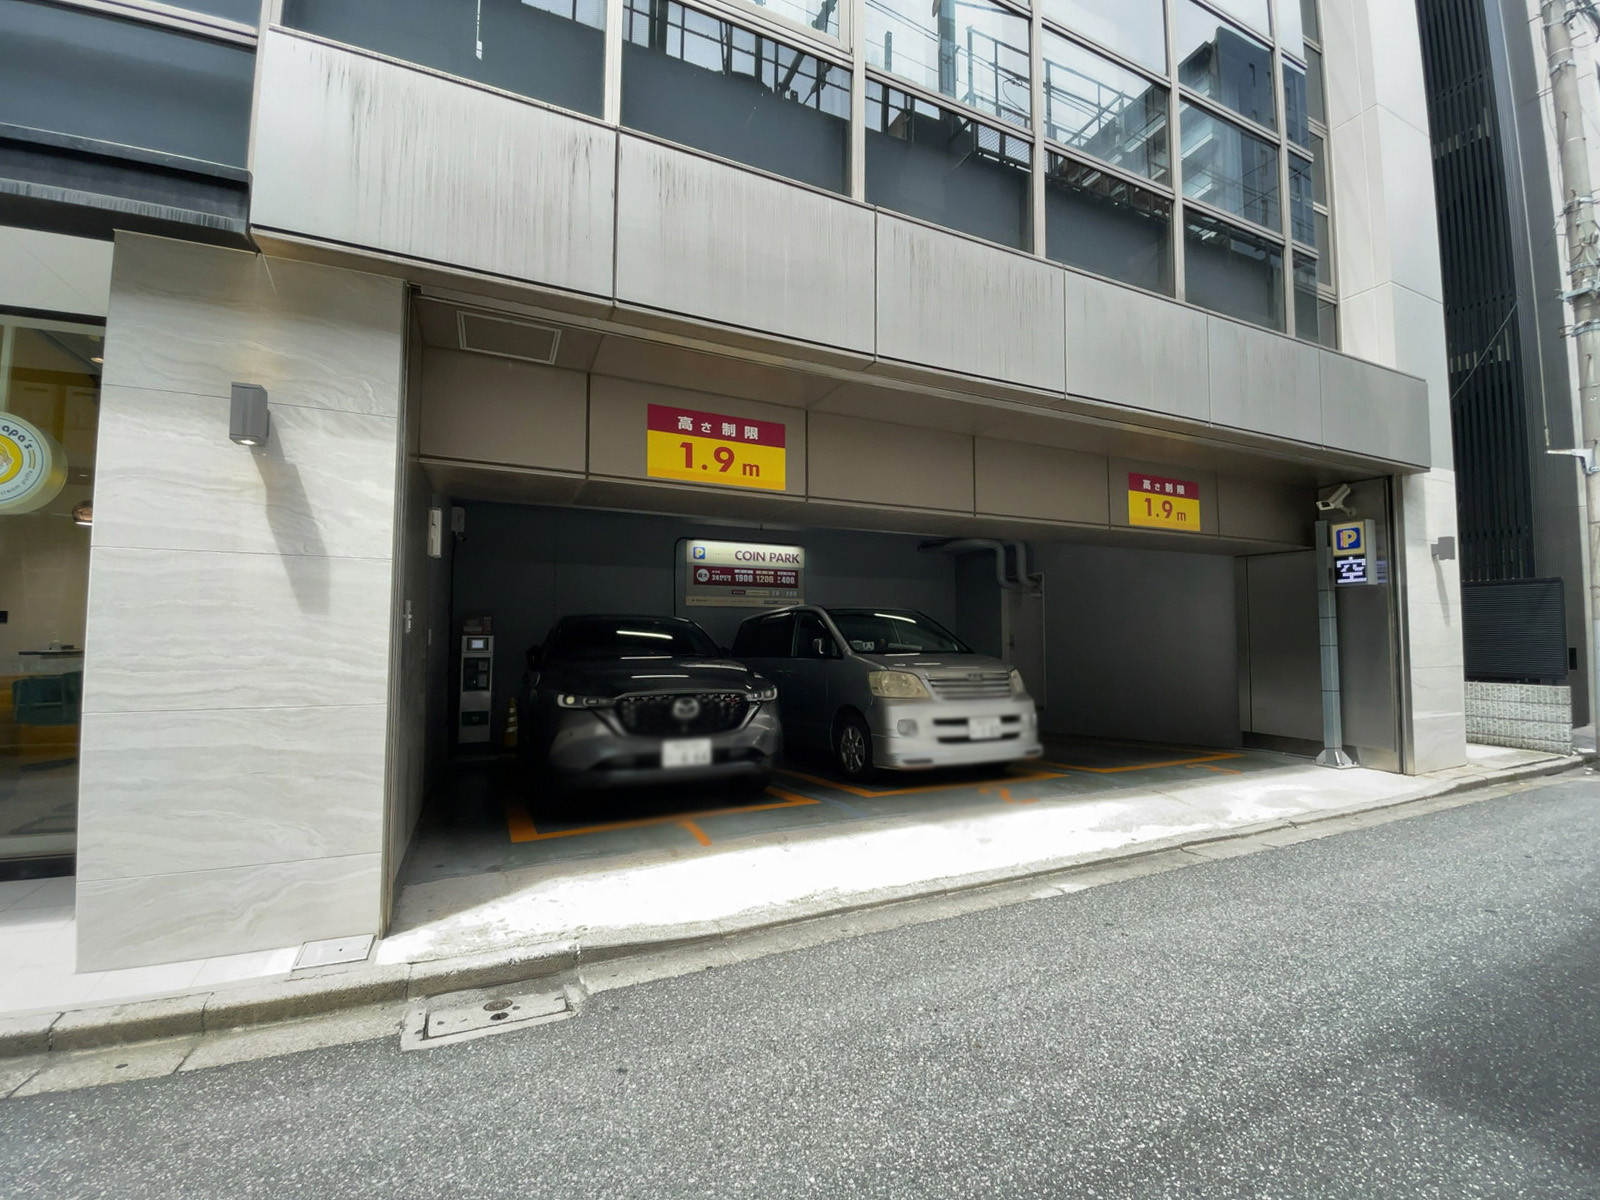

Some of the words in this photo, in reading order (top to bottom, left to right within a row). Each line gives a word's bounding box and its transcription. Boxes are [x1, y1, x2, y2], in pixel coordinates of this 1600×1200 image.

[678, 416, 759, 440] 高さ制限
[1142, 479, 1185, 495] 高さ制限
[734, 550, 766, 562] COIN
[769, 553, 800, 564] PARK
[1336, 556, 1367, 583] 空
